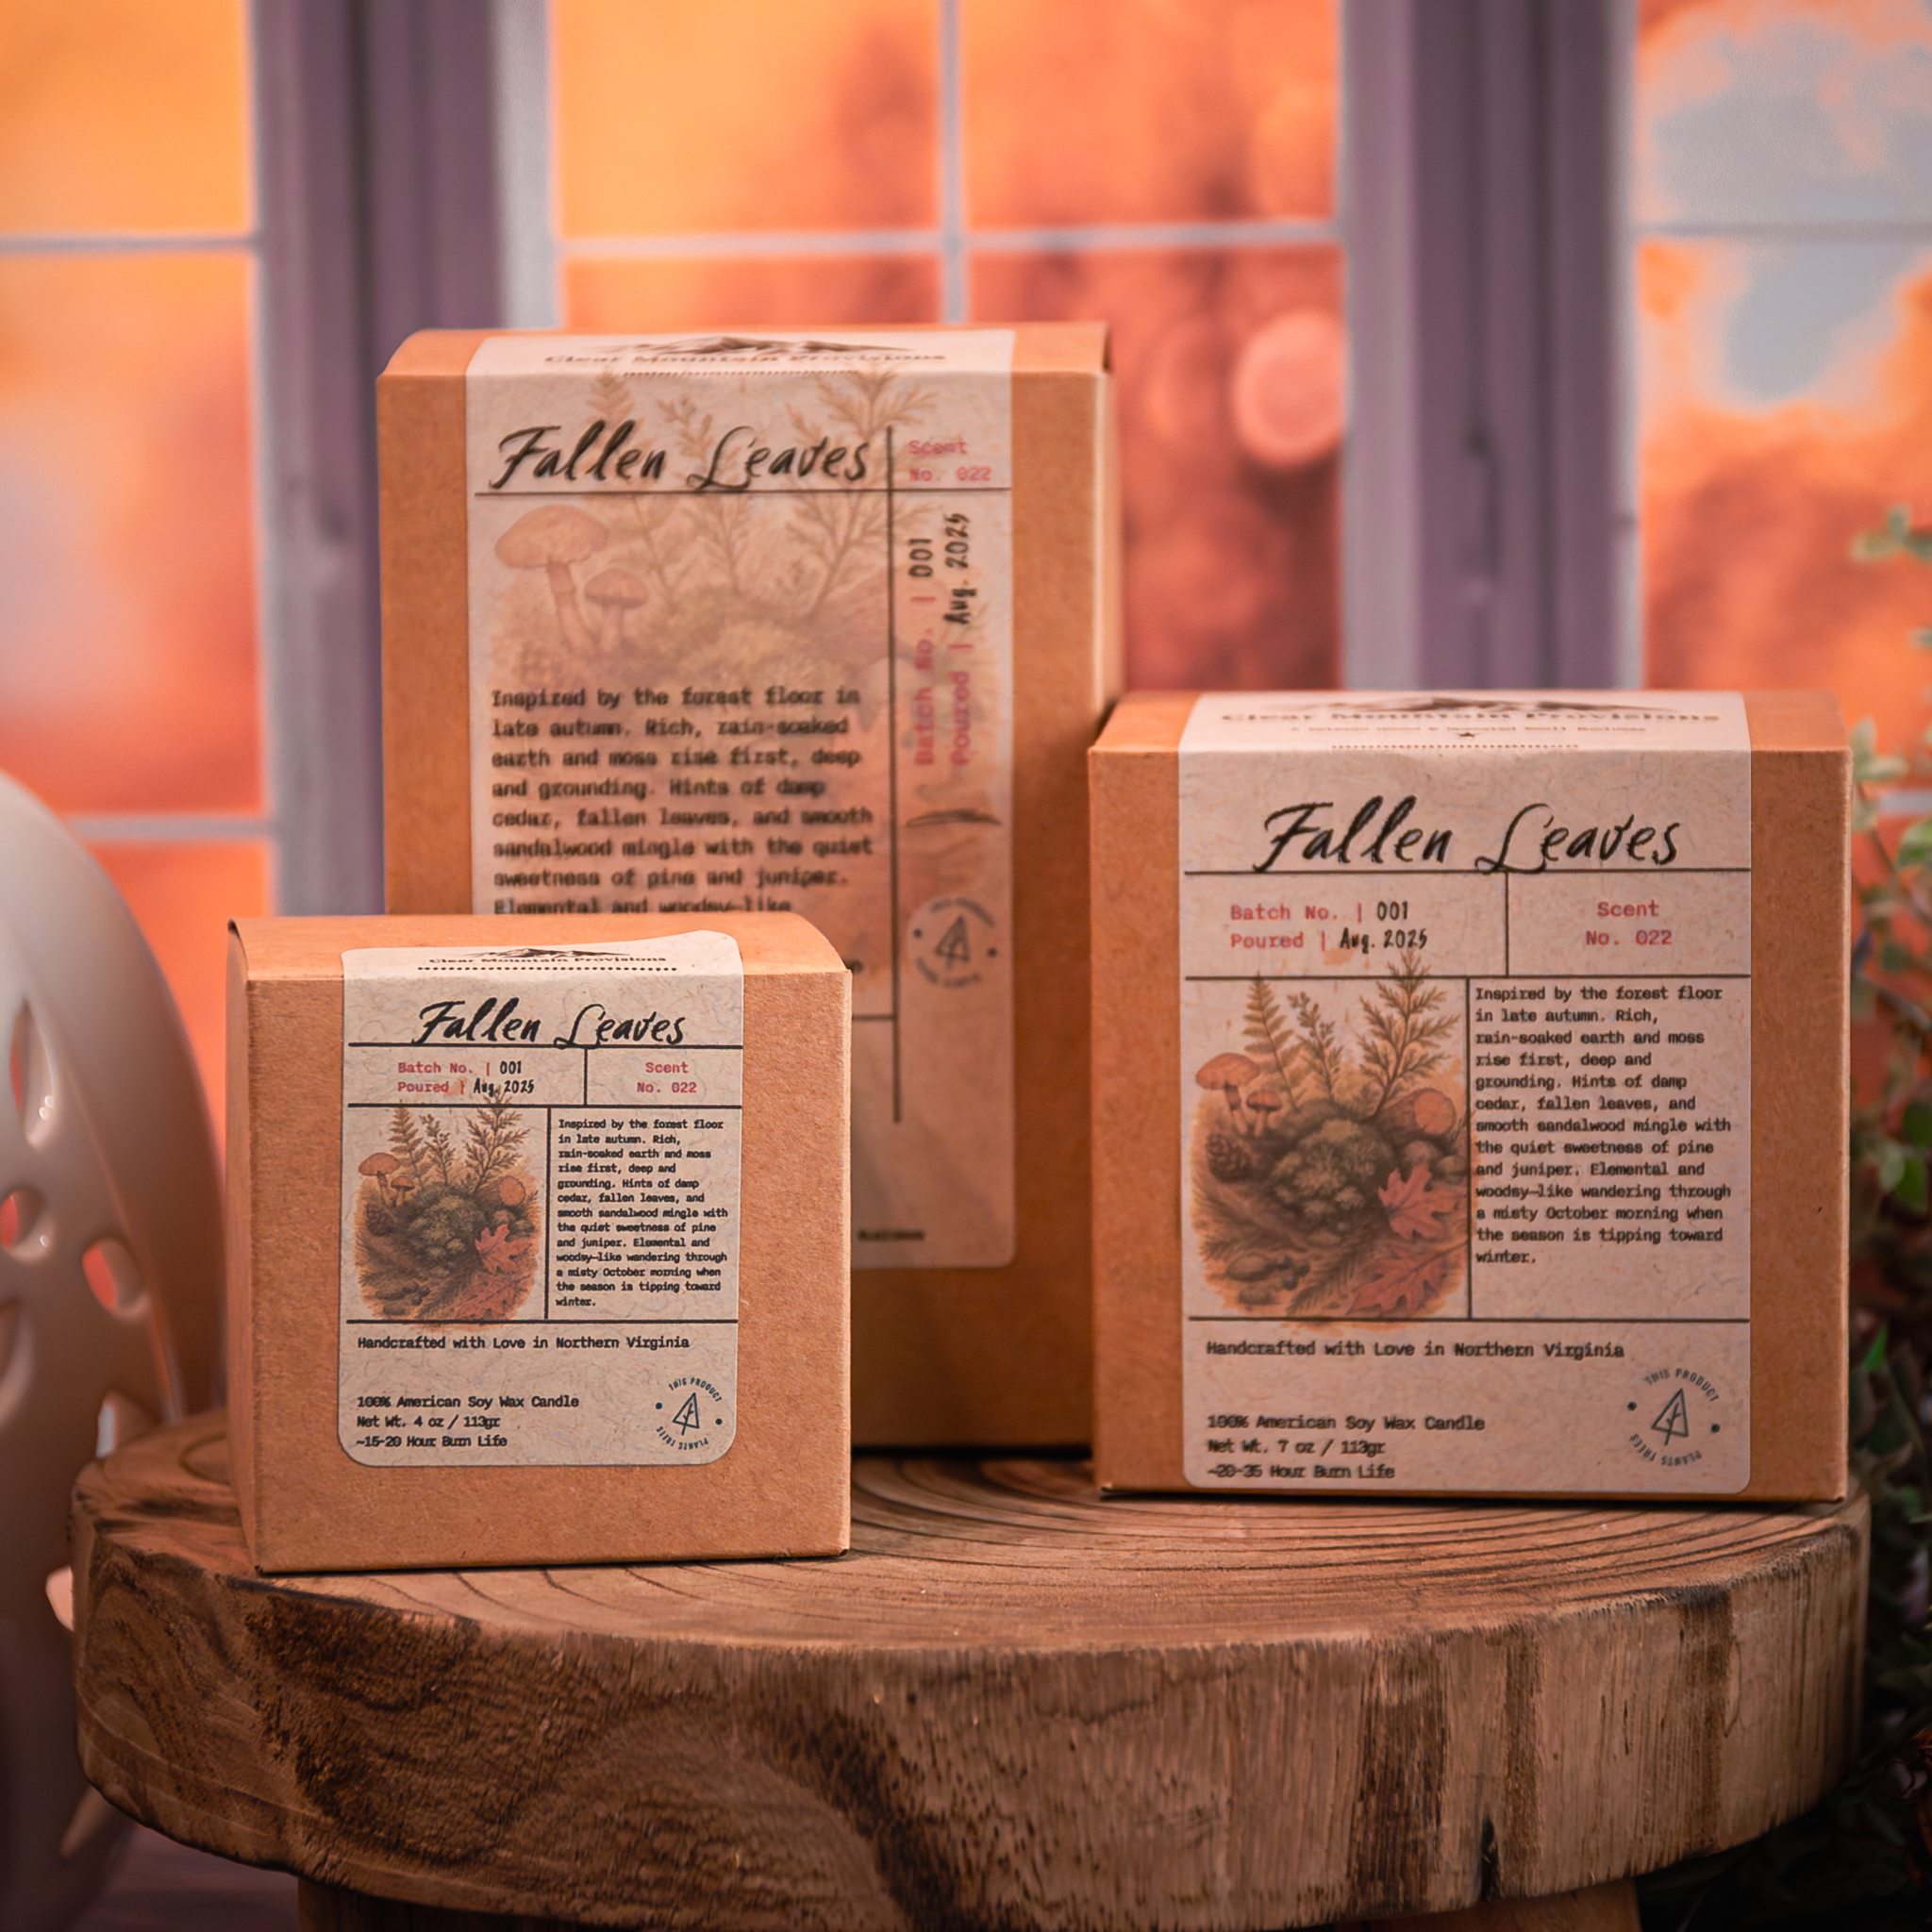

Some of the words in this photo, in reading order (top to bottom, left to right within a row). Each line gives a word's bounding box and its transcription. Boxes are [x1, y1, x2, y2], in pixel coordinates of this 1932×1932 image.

[489, 419, 666, 490] Fallen
[687, 425, 871, 490] Leaves
[957, 466, 991, 481] 022
[943, 513, 971, 569] 2025
[908, 538, 934, 577] 001
[1253, 795, 1452, 873] Fallen
[1474, 803, 1680, 874] Leaves
[1230, 903, 1291, 921] Batch
[1305, 905, 1338, 921] No.
[1376, 900, 1408, 921] 001
[1596, 899, 1659, 918] Scent
[1230, 931, 1304, 949] Poured
[1340, 927, 1375, 955] Aug.
[1383, 927, 1428, 950] 2025
[1586, 928, 1621, 945] No.
[1635, 927, 1674, 946] 022
[1475, 987, 1545, 1003] Inspired
[1555, 986, 1572, 1003] by
[1580, 986, 1607, 1000] the
[1616, 986, 1669, 1000] forest
[1677, 985, 1723, 1000] floor
[412, 997, 541, 1045] Fallen
[554, 1004, 685, 1049] Leaves
[1475, 1008, 1492, 1022] in
[1501, 1008, 1537, 1023] late
[1545, 1008, 1605, 1023] autumn.
[1615, 1008, 1657, 1024] Rich,
[1475, 1030, 1572, 1044] rain-soaked
[1580, 1030, 1624, 1044] earth
[1633, 1029, 1660, 1044] and
[1668, 1033, 1705, 1044] moss
[397, 1061, 441, 1074] Batch
[450, 1063, 474, 1074] No.
[499, 1060, 522, 1074] 001
[645, 1060, 689, 1074] Scent
[1475, 1055, 1510, 1066] rise
[1519, 1052, 1569, 1069] first,
[1580, 1053, 1617, 1069] deep
[1624, 1052, 1652, 1066] and
[397, 1080, 449, 1092] Poured
[504, 1079, 535, 1093] 2025
[637, 1081, 661, 1093] No.
[671, 1081, 697, 1093] 022
[1475, 1074, 1561, 1091] grounding.
[1572, 1074, 1616, 1089] Hints
[1623, 1074, 1642, 1088] of
[1651, 1074, 1687, 1091] damp
[1475, 1097, 1525, 1112] cedar,
[1537, 1095, 1590, 1110] fallen
[1599, 1095, 1657, 1112] leaves,
[1669, 1095, 1695, 1110] and
[1475, 1118, 1528, 1132] smooth
[1537, 1118, 1625, 1132] sandalwood
[1633, 1118, 1687, 1136] mingle
[1695, 1117, 1731, 1132] with
[557, 1235, 577, 1247] and
[581, 1237, 626, 1249] juniper.
[633, 1237, 686, 1247] Elemental
[691, 1238, 710, 1247] and
[568, 1267, 601, 1278] misty
[603, 1267, 645, 1276] October
[650, 1267, 691, 1278] morning
[696, 1267, 721, 1276] when
[556, 1281, 575, 1291] the
[621, 1281, 633, 1291] is
[639, 1281, 680, 1293] tipping
[683, 1281, 721, 1293] toward
[556, 1296, 595, 1307] winter.
[358, 1336, 445, 1349] Handcrafted
[453, 1336, 486, 1349] with
[493, 1338, 525, 1349] Love
[533, 1336, 548, 1348] in
[556, 1336, 620, 1348] Northern
[626, 1335, 691, 1351] Virginia
[1207, 1340, 1316, 1356] Handcrafted
[1324, 1341, 1365, 1357] with
[1374, 1342, 1415, 1357] Love
[1424, 1341, 1444, 1357] in
[1453, 1341, 1534, 1357] Northern
[1542, 1341, 1624, 1360] Virginia
[1675, 1368, 1719, 1402] PRODUCT
[357, 1396, 391, 1407] 100%
[396, 1395, 461, 1407] American
[468, 1396, 493, 1410] Soy
[499, 1396, 525, 1407] Wax
[531, 1394, 579, 1407] Candle
[357, 1416, 379, 1427] Net
[385, 1415, 406, 1427] Wt.
[413, 1416, 423, 1427] 4
[428, 1417, 444, 1427] oz
[447, 1414, 459, 1430] /
[464, 1416, 501, 1430] 113gr
[1208, 1414, 1249, 1428] 100%
[1256, 1414, 1336, 1429] American
[1345, 1415, 1375, 1433] Soy
[1382, 1416, 1415, 1430] Wax
[1424, 1415, 1485, 1430] Candle
[407, 1436, 437, 1447] Hour
[442, 1436, 471, 1447] Burn
[478, 1435, 508, 1446] Life
[1208, 1440, 1235, 1454] Net
[1242, 1439, 1268, 1454] Wt.
[1278, 1440, 1289, 1453] 7
[1295, 1442, 1315, 1454] oz
[1321, 1439, 1334, 1457] /
[1341, 1441, 1386, 1457] 113gr
[1270, 1465, 1306, 1478] Hour
[1313, 1465, 1351, 1478] Burn
[1357, 1464, 1395, 1478] Life
